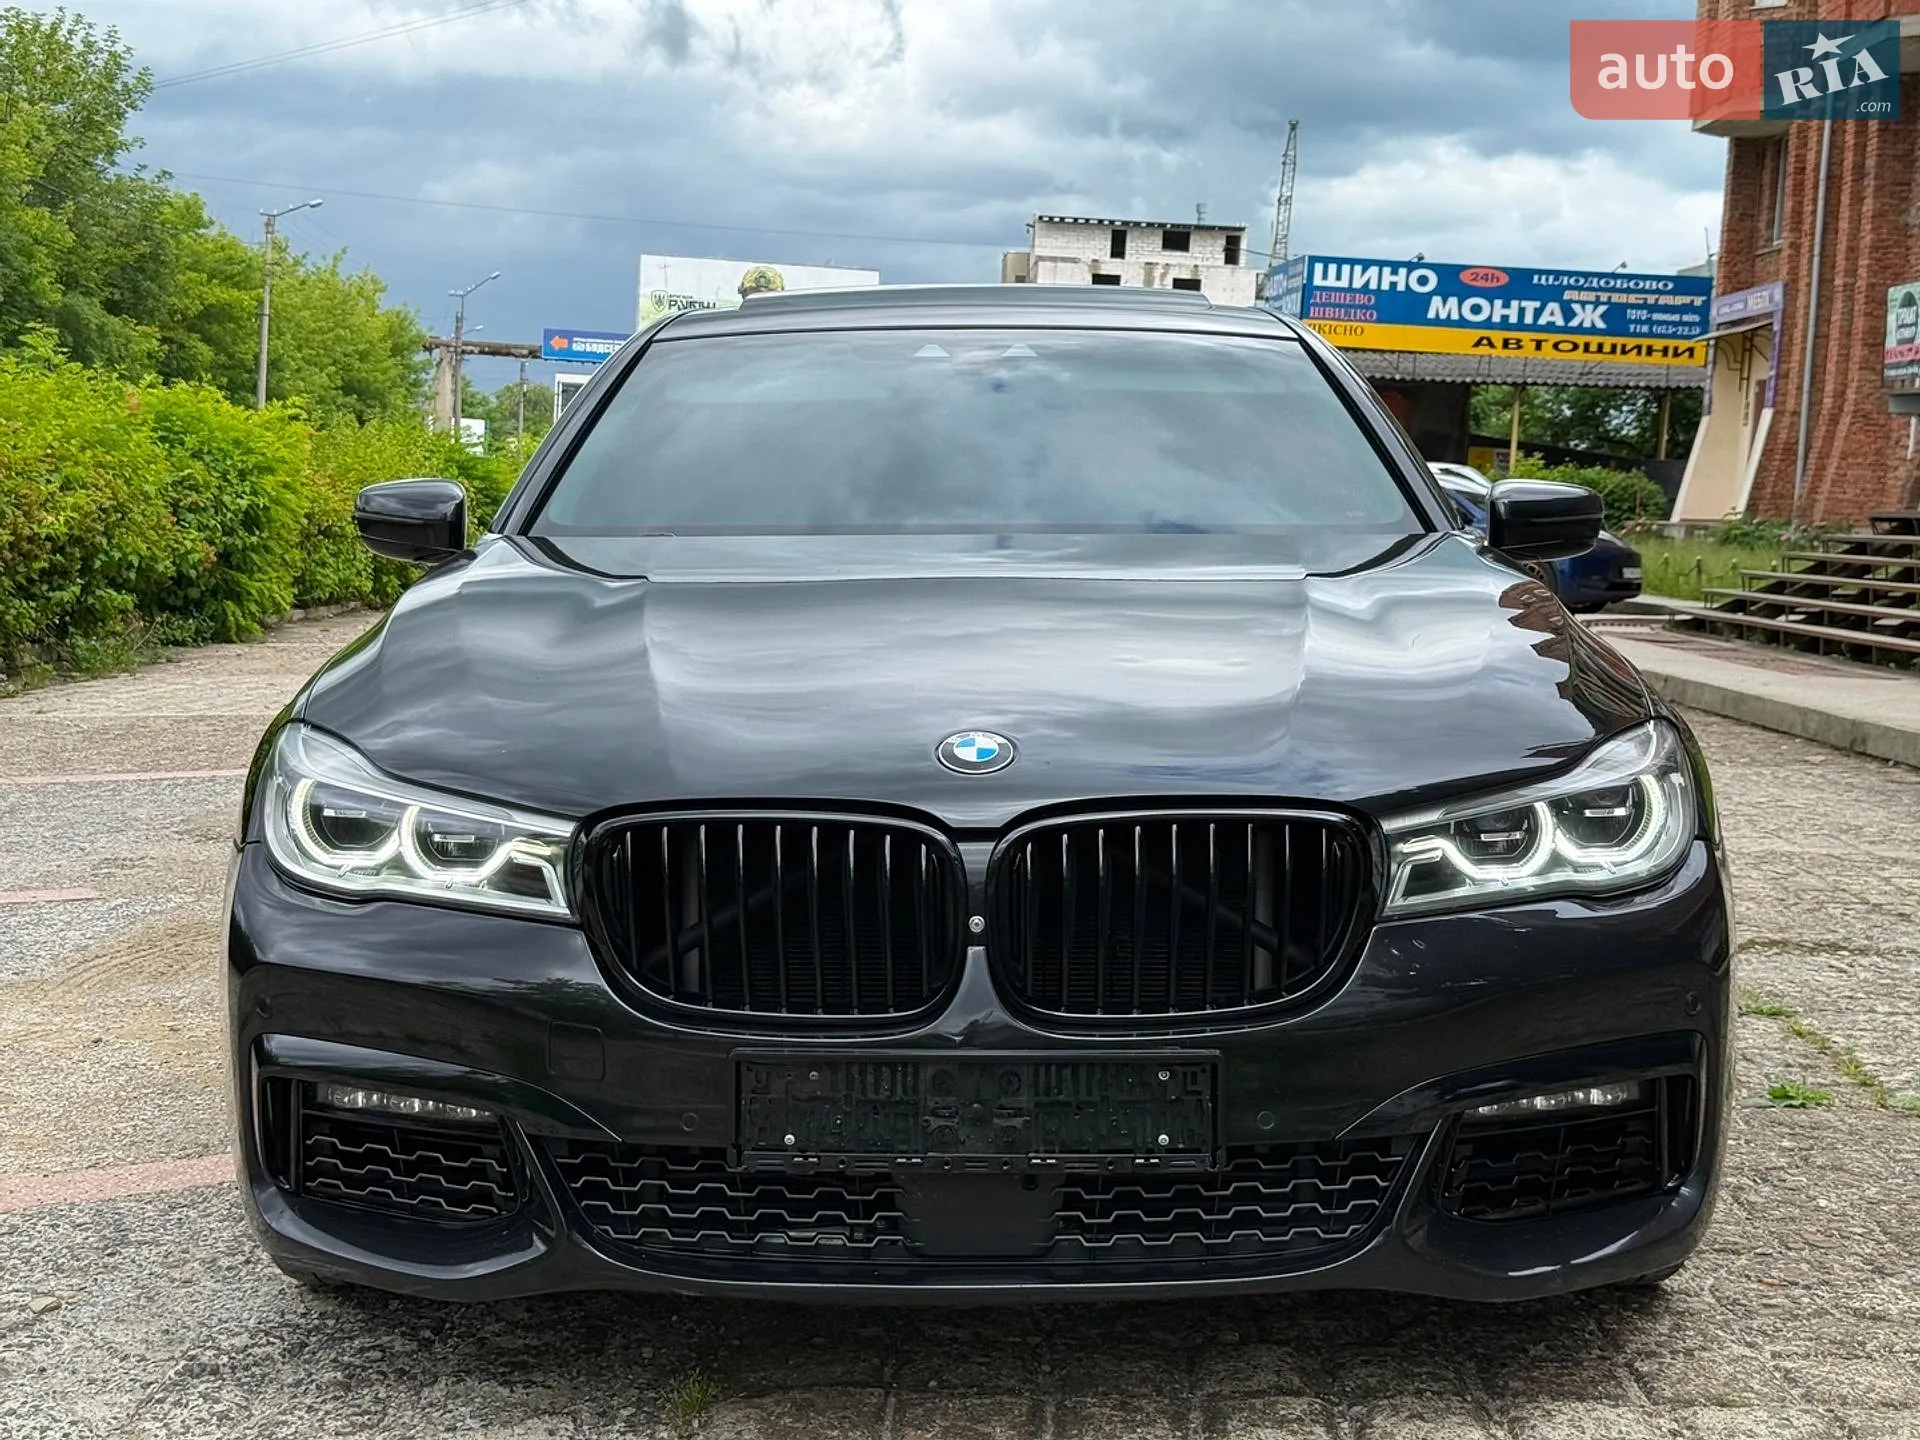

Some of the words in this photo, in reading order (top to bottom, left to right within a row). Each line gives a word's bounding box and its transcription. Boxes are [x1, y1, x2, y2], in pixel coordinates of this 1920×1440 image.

[1313, 262, 1438, 293] ШИНО
[1468, 271, 1500, 284] 24h
[1310, 290, 1376, 305] ДЕШЕВО
[1309, 306, 1377, 321] ШВИДКО
[1427, 295, 1610, 329] МОНТАЖ
[1471, 335, 1695, 359] АВТОШИНИ
